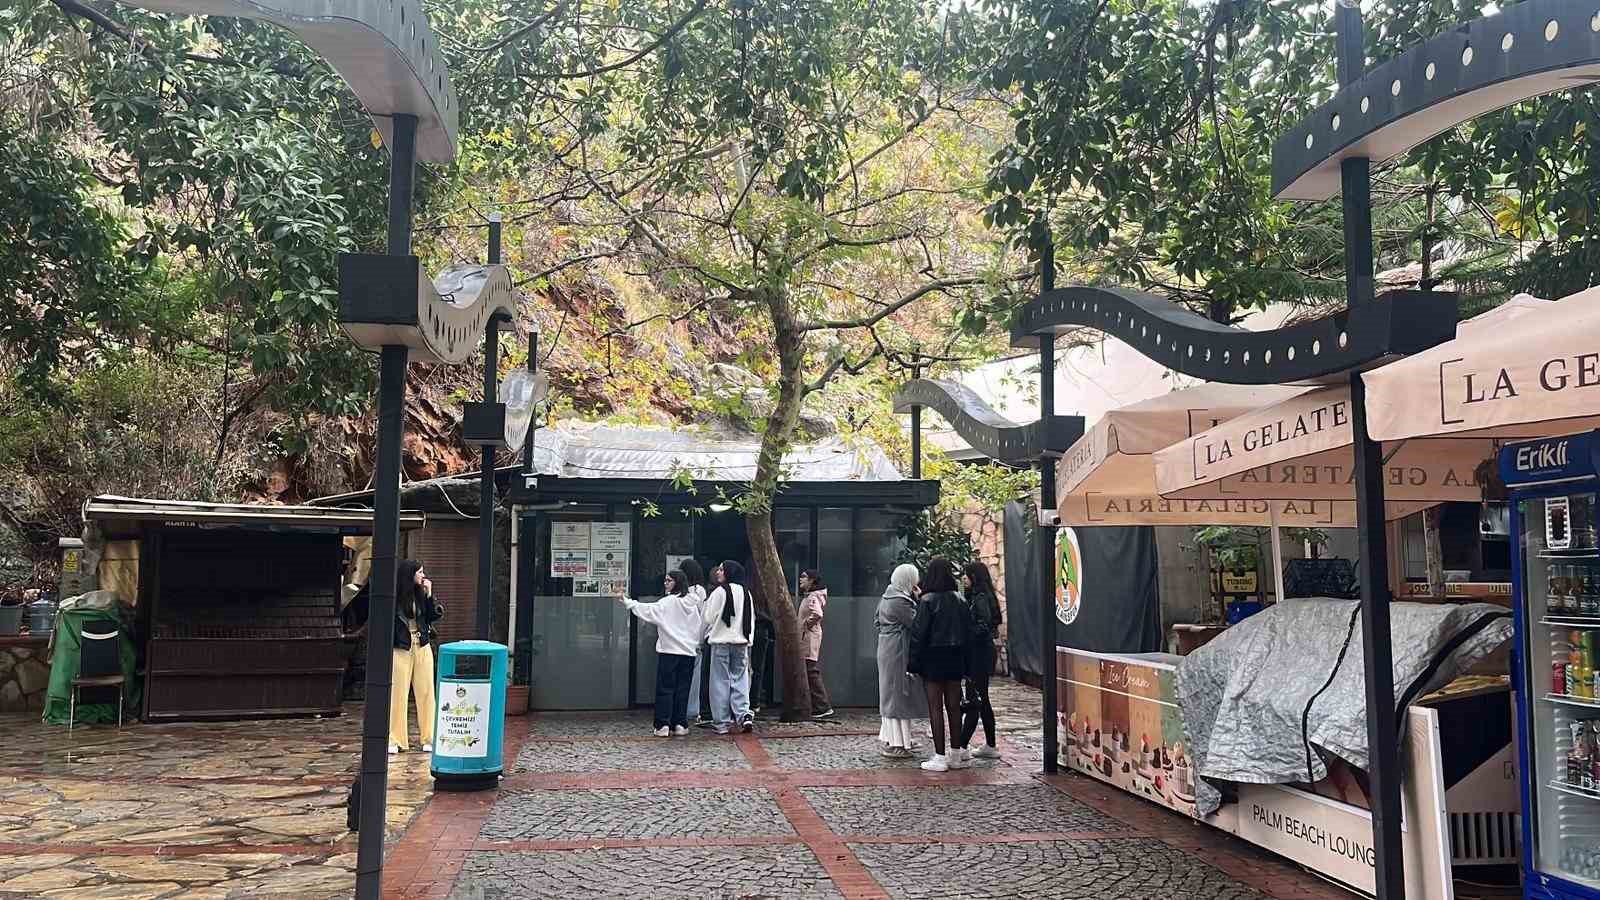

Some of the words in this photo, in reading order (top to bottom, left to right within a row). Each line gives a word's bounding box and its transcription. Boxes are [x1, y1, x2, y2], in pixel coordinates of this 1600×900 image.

[1463, 367, 1519, 404] LA
[1205, 439, 1233, 465] LA
[1243, 402, 1348, 452] GELATE
[1516, 440, 1568, 471] Erikli
[1253, 804, 1283, 832] PALM
[1285, 816, 1326, 849] BEACH
